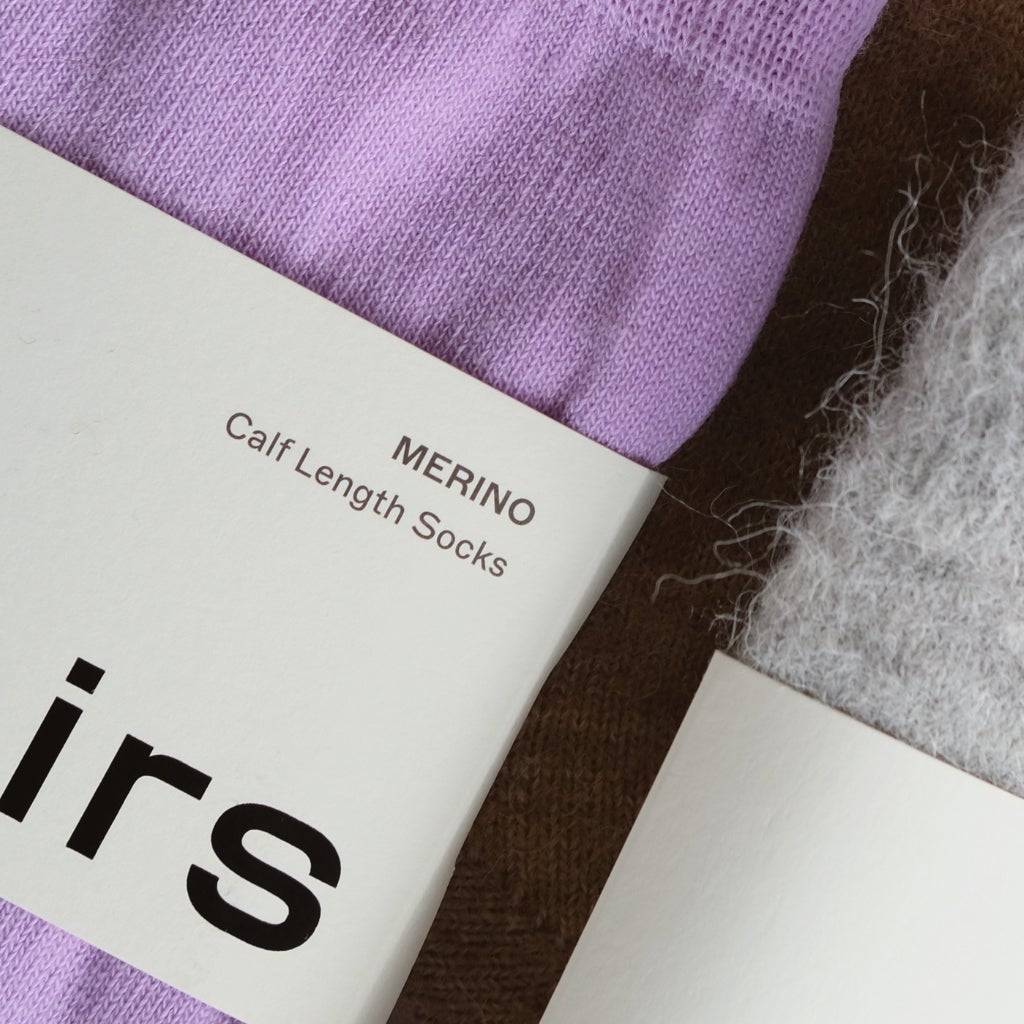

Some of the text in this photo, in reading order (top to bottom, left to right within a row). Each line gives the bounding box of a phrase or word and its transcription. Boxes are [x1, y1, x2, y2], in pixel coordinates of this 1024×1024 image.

[225, 411, 509, 578] Calf Length Socks
[391, 435, 537, 526] MERINO
